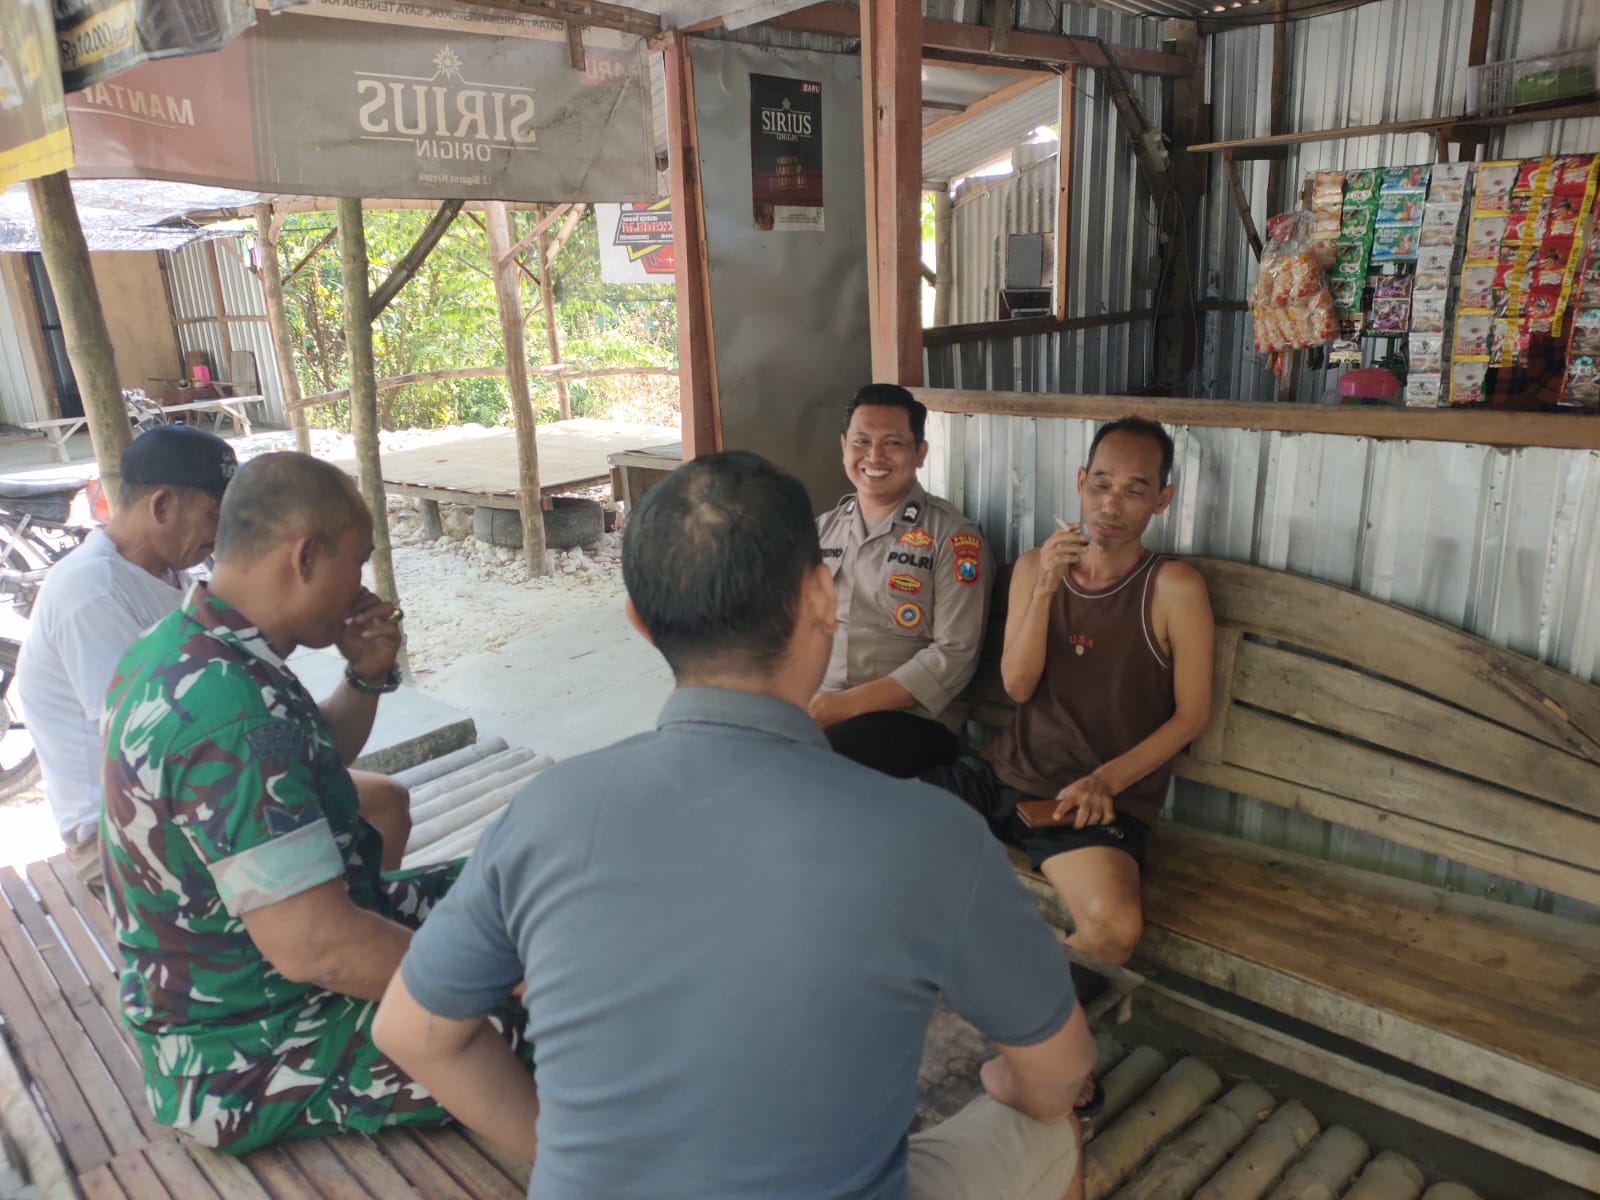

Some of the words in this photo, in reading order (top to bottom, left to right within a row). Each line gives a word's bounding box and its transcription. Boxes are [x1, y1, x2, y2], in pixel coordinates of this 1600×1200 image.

[762, 110, 812, 134] SIRIUS
[777, 132, 799, 142] ORIGIN
[887, 551, 934, 572] POLRI
